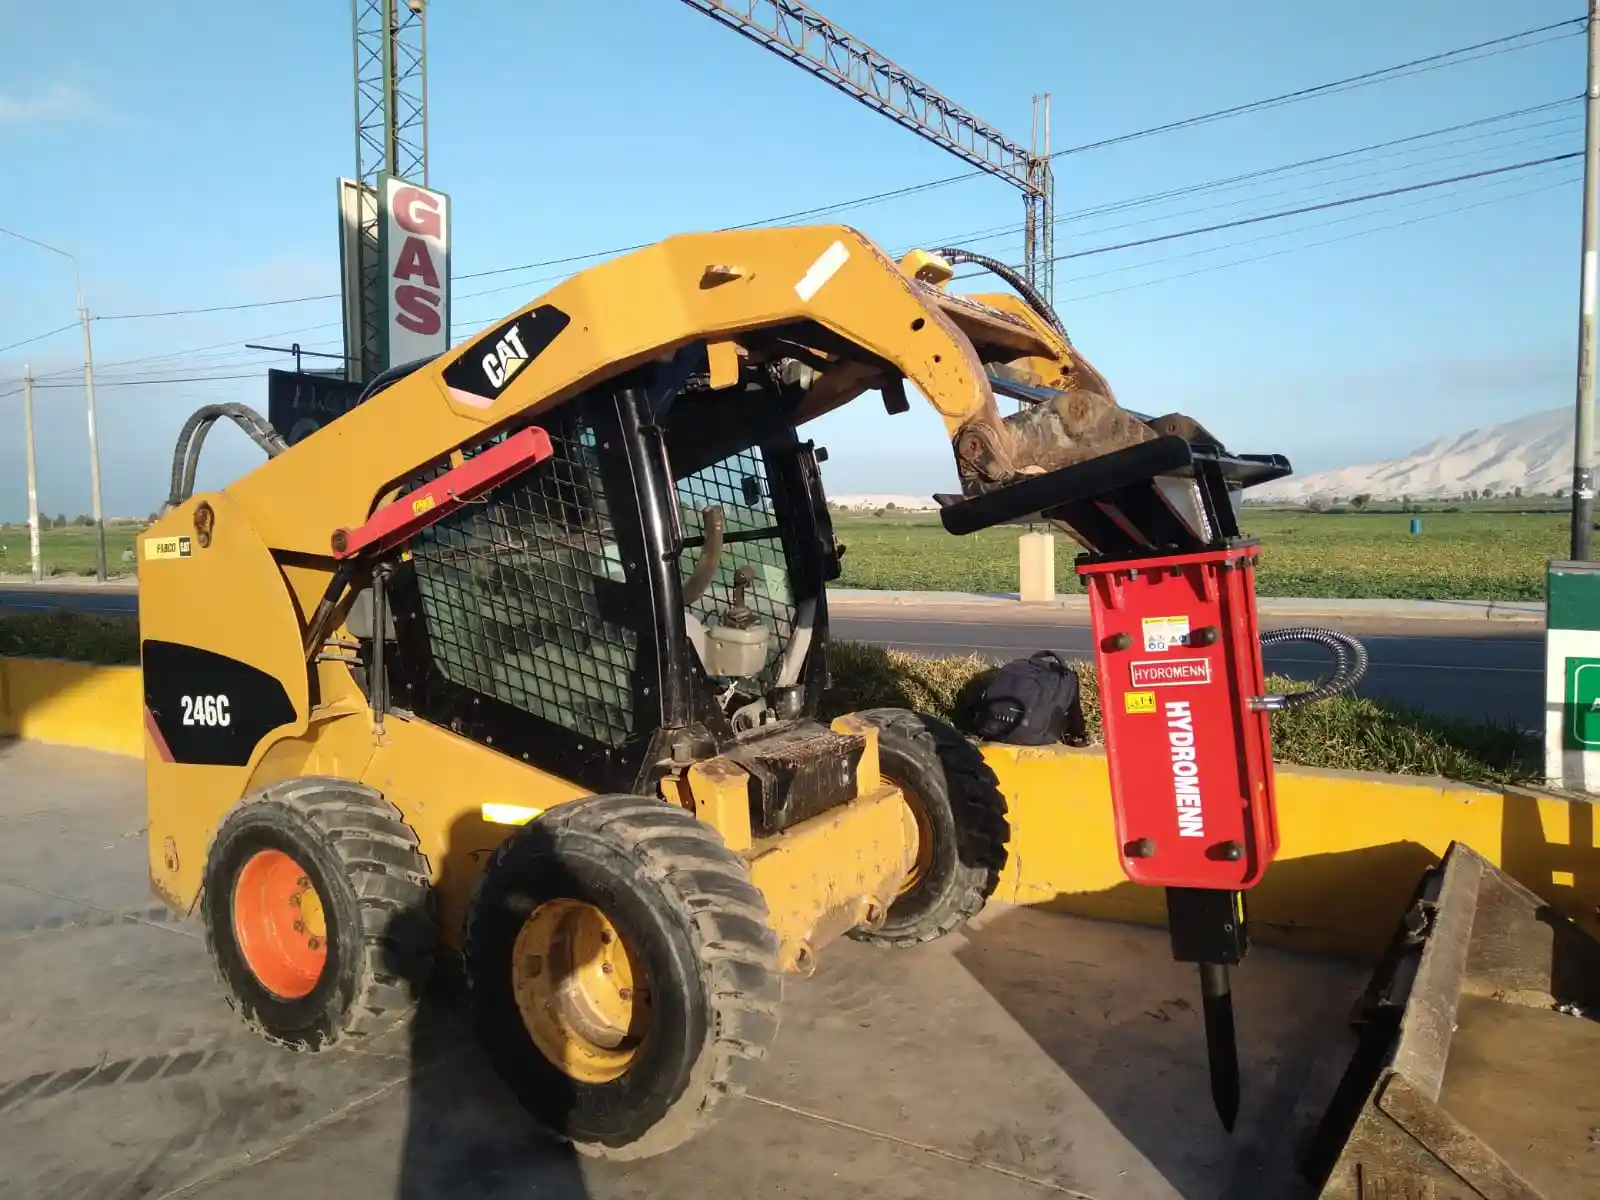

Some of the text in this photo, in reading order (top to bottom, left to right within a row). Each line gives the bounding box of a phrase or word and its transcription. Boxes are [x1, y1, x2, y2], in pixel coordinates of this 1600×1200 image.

[392, 186, 442, 336] GAS
[482, 325, 529, 388] CAT
[1134, 665, 1206, 680] HYDROMENN
[181, 694, 231, 727] 246C
[1165, 701, 1205, 837] HYDROMENN
